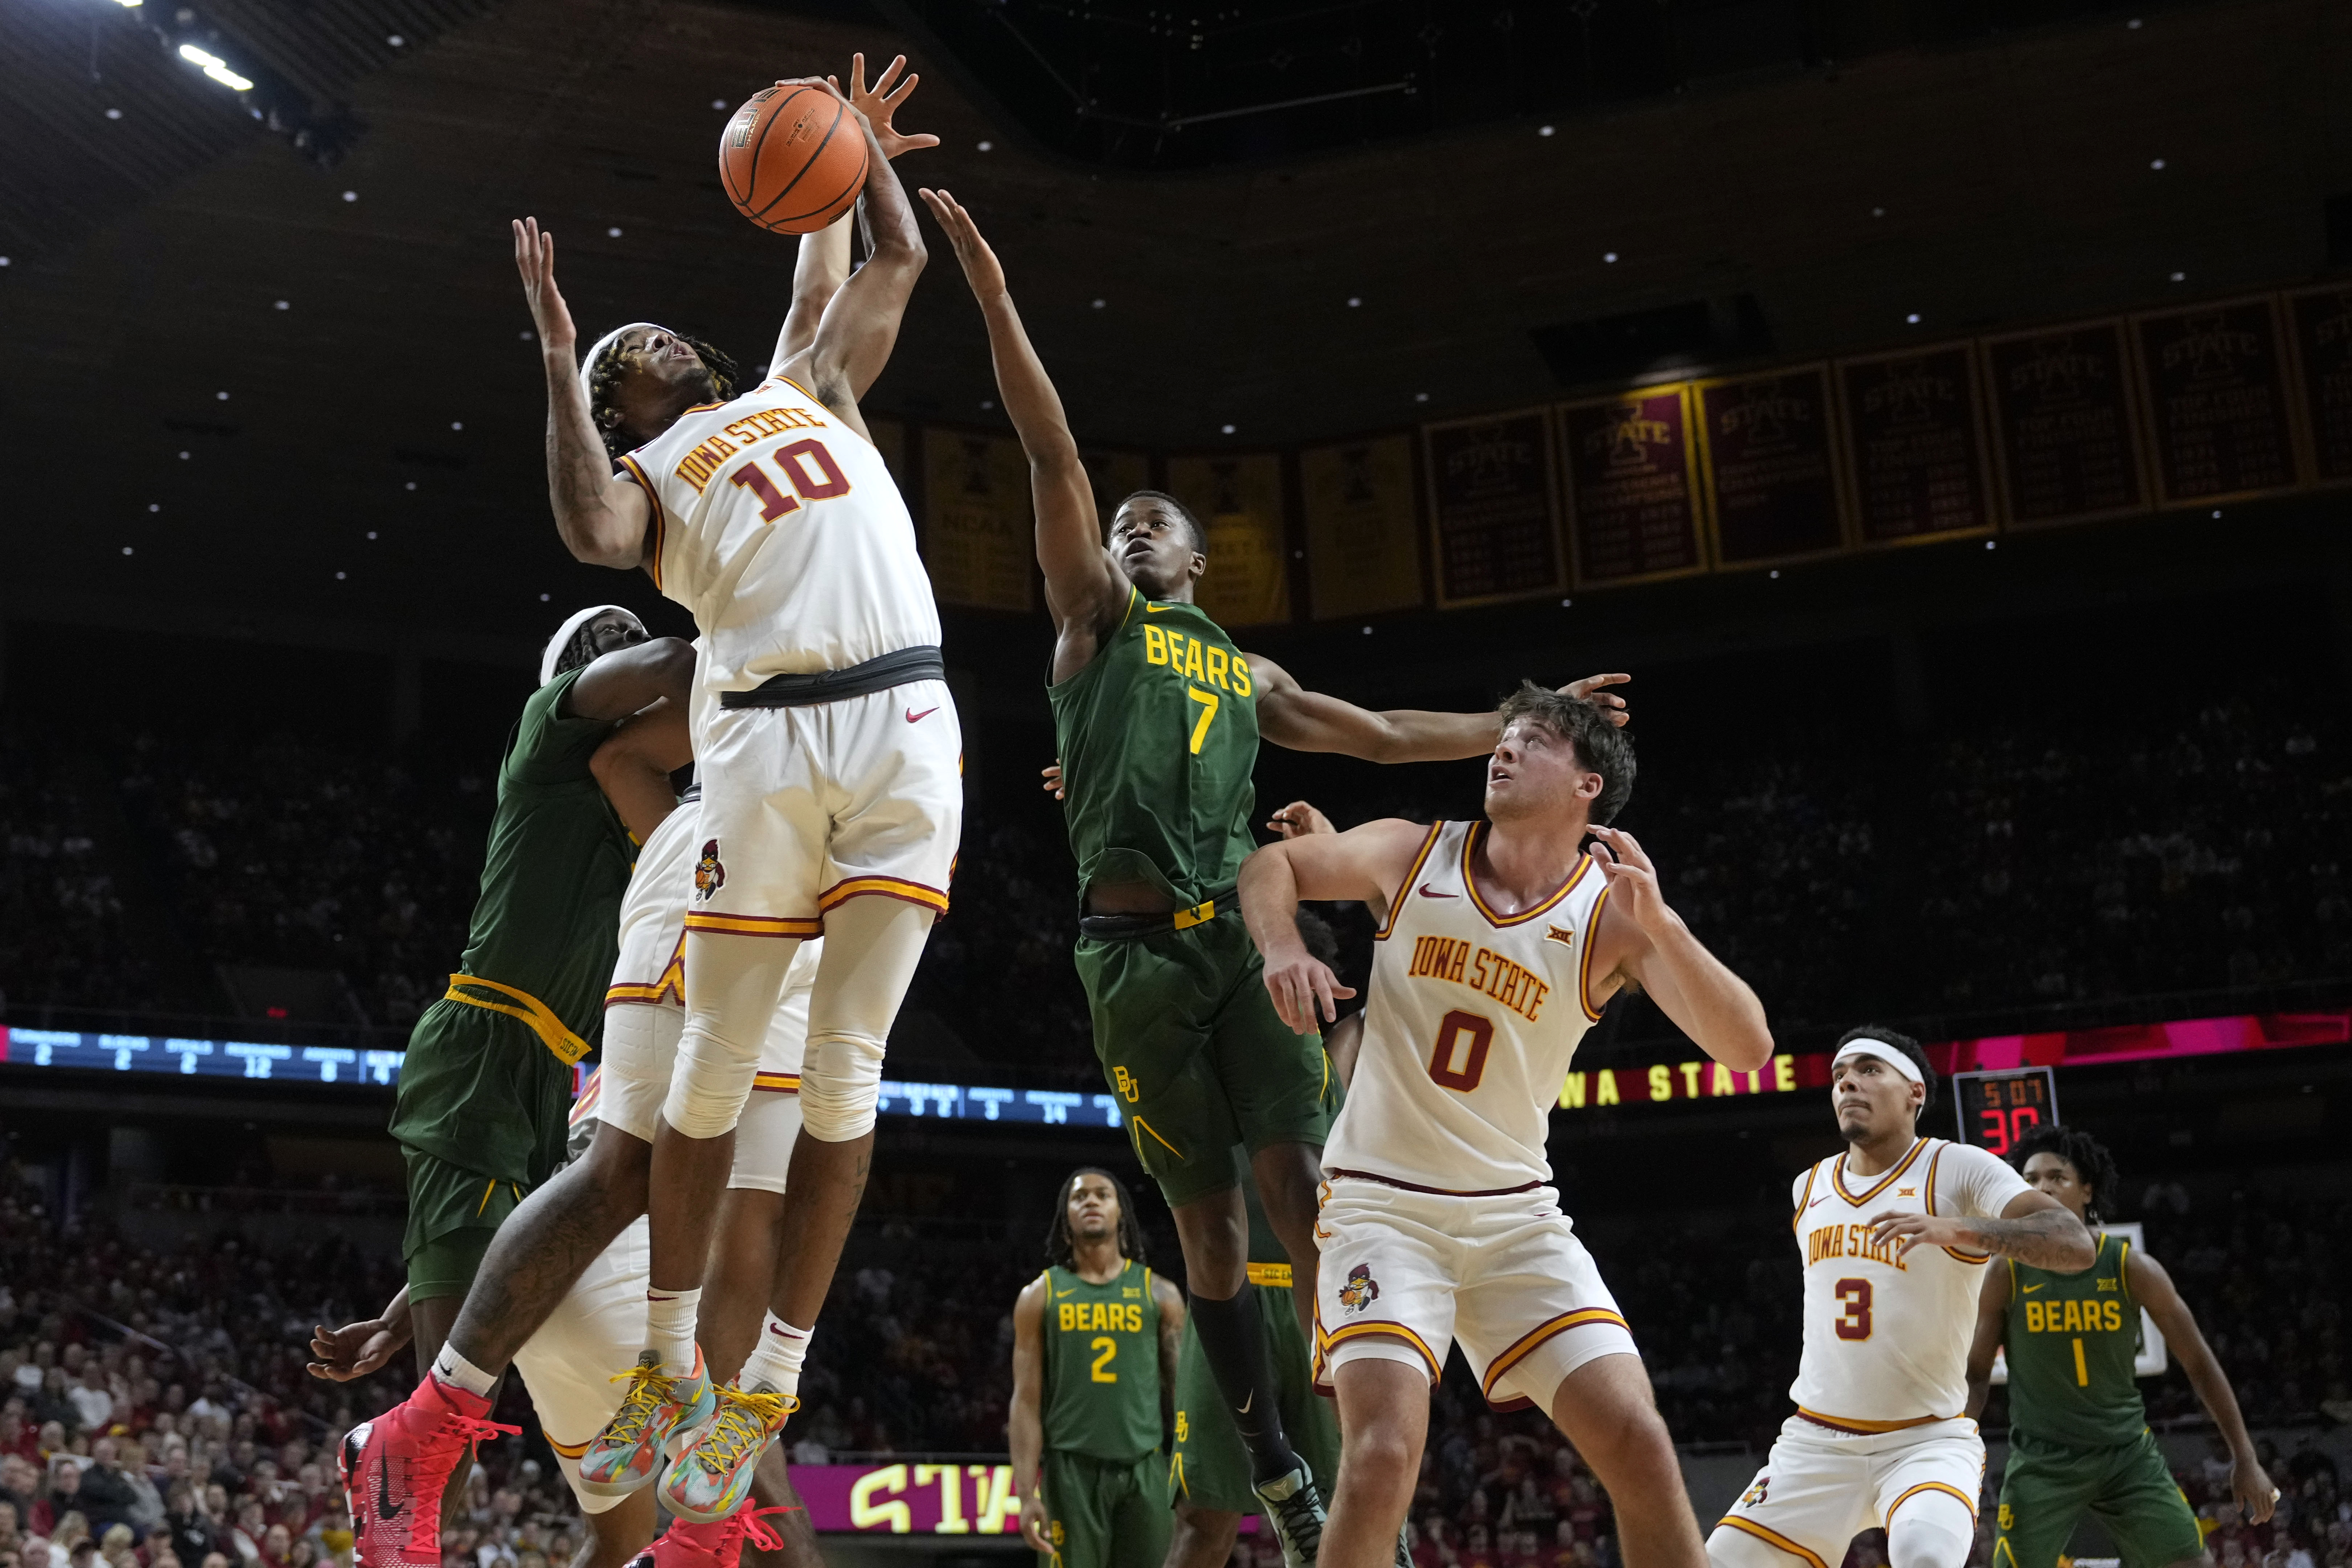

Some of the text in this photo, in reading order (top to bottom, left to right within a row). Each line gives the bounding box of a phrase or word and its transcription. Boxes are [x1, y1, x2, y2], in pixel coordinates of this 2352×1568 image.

[675, 408, 828, 497] IOWA STATE
[729, 438, 852, 525] 10
[1143, 623, 1251, 697] BEARS
[1189, 685, 1219, 755] 7
[1408, 935, 1550, 1024] IOWA STATE
[1429, 1008, 1494, 1094] 0
[1113, 1066, 1139, 1103] BU
[1809, 1224, 1845, 1267] IOWA
[1059, 1303, 1143, 1333] BEARS
[1835, 1277, 1873, 1341] 3
[2026, 1299, 2122, 1333] BEARS
[1091, 1336, 1118, 1383] 2
[2072, 1338, 2088, 1387] 1
